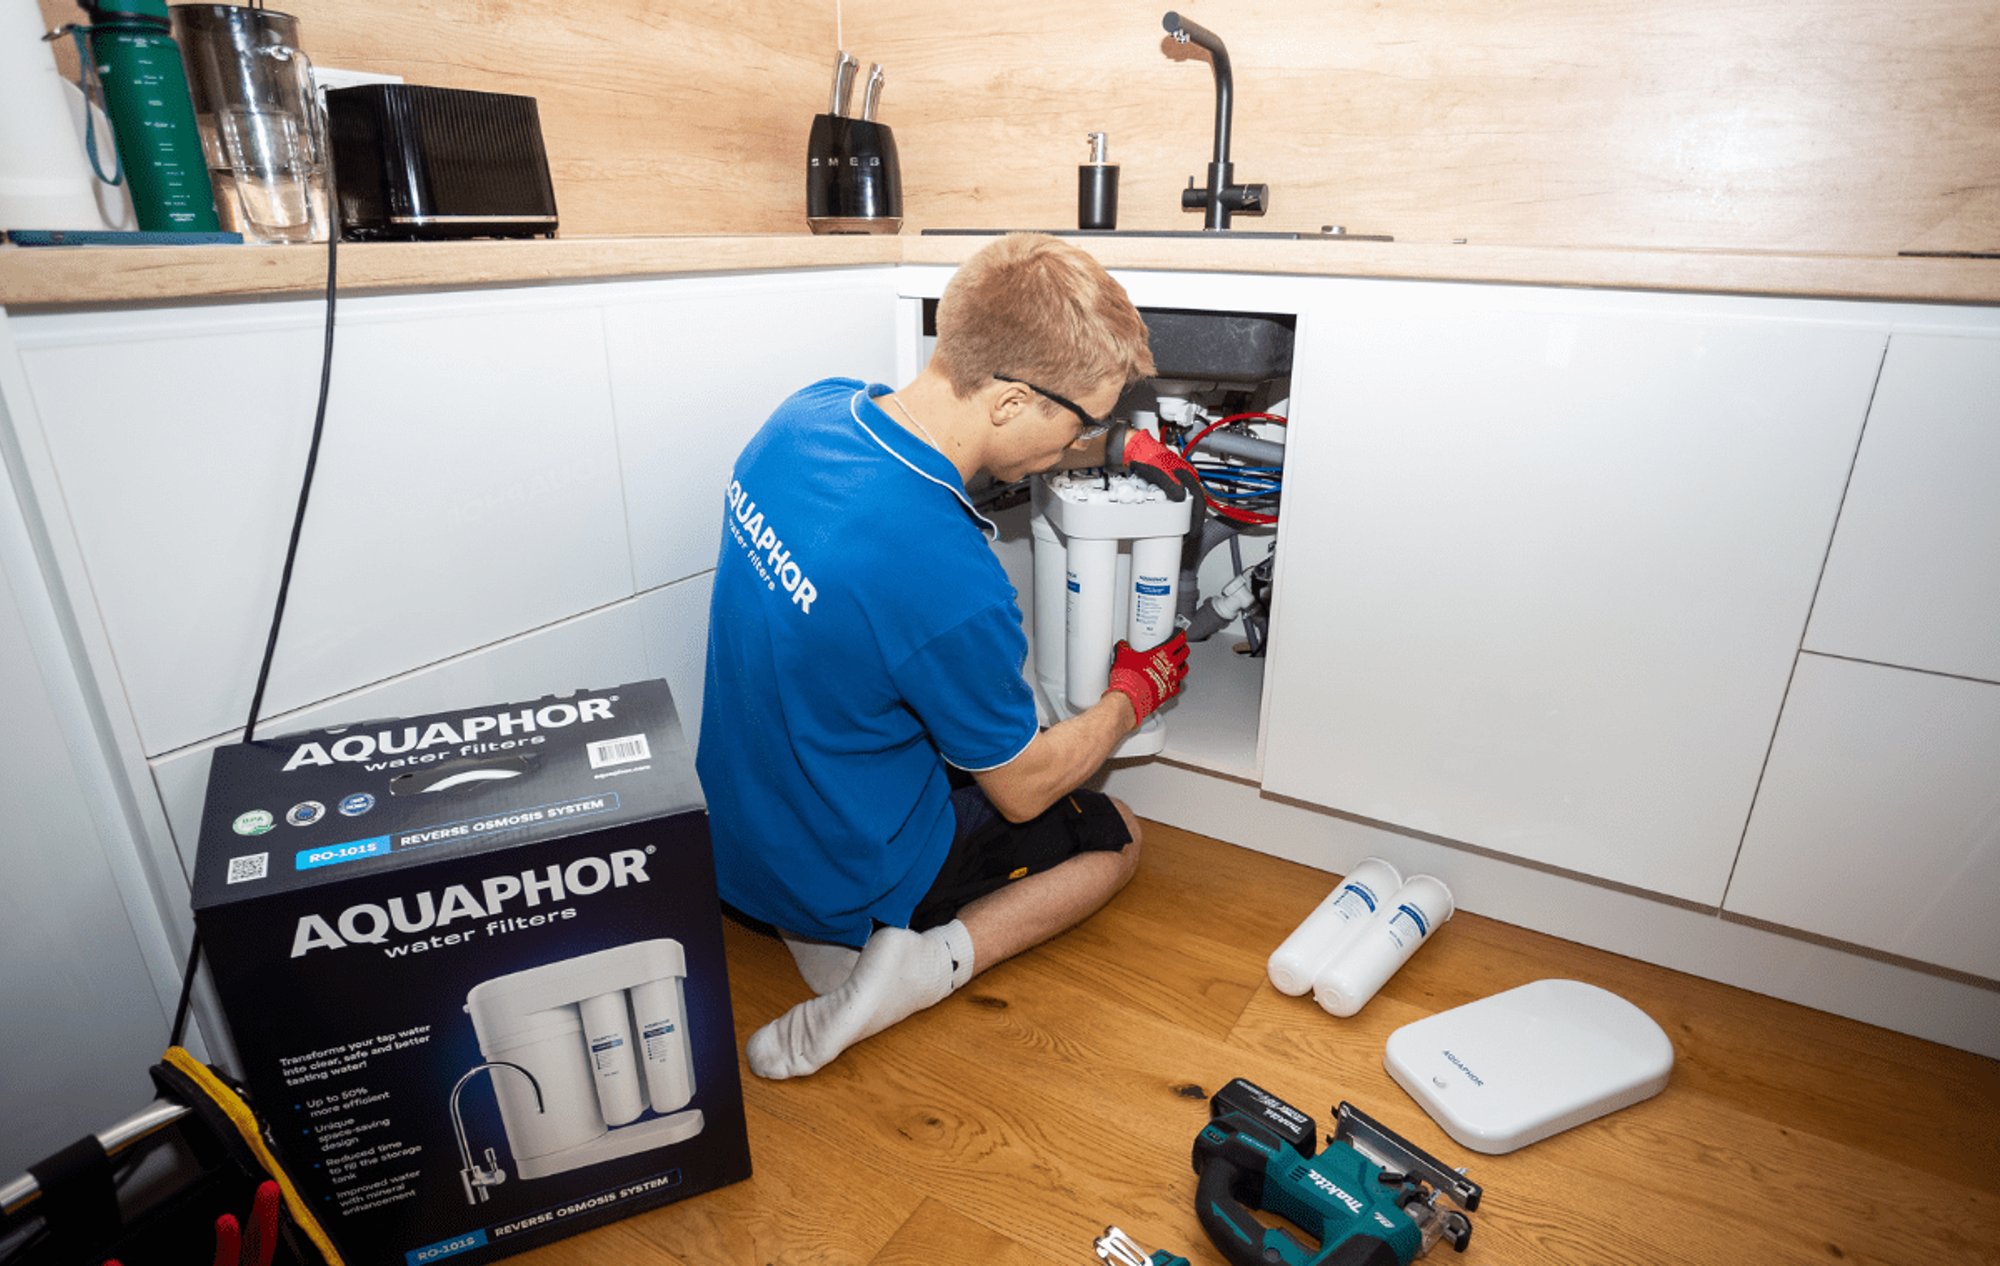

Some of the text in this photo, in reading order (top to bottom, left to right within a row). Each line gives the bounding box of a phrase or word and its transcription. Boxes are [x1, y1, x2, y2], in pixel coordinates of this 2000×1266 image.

[811, 156, 880, 167] SMEG
[727, 474, 818, 614] QUAPHOR
[364, 733, 546, 773] water filters
[400, 798, 605, 847] REVERSE OSMOSIS SYSTEM
[308, 843, 377, 863] RO-101S
[384, 906, 578, 959] water filters
[279, 1024, 431, 1067] Transforms your tap water
[282, 1034, 431, 1077] into clear, safe and better
[286, 1060, 368, 1087] tasting water!
[306, 1098, 324, 1109] Up
[326, 1094, 340, 1104] to
[310, 1091, 391, 1118] more efficient
[314, 1117, 355, 1134] Unique
[321, 1136, 359, 1152] design
[325, 1141, 403, 1167] Reduced time
[329, 1164, 342, 1176] to
[381, 1144, 422, 1162] storage
[332, 1172, 357, 1185] tank
[390, 1169, 421, 1184] water
[339, 1182, 406, 1208] with mineral
[342, 1189, 416, 1217] enhancement
[494, 1176, 669, 1237] REVERSE OSMOSIS SYSTEM
[417, 1236, 476, 1262] RO-101S
